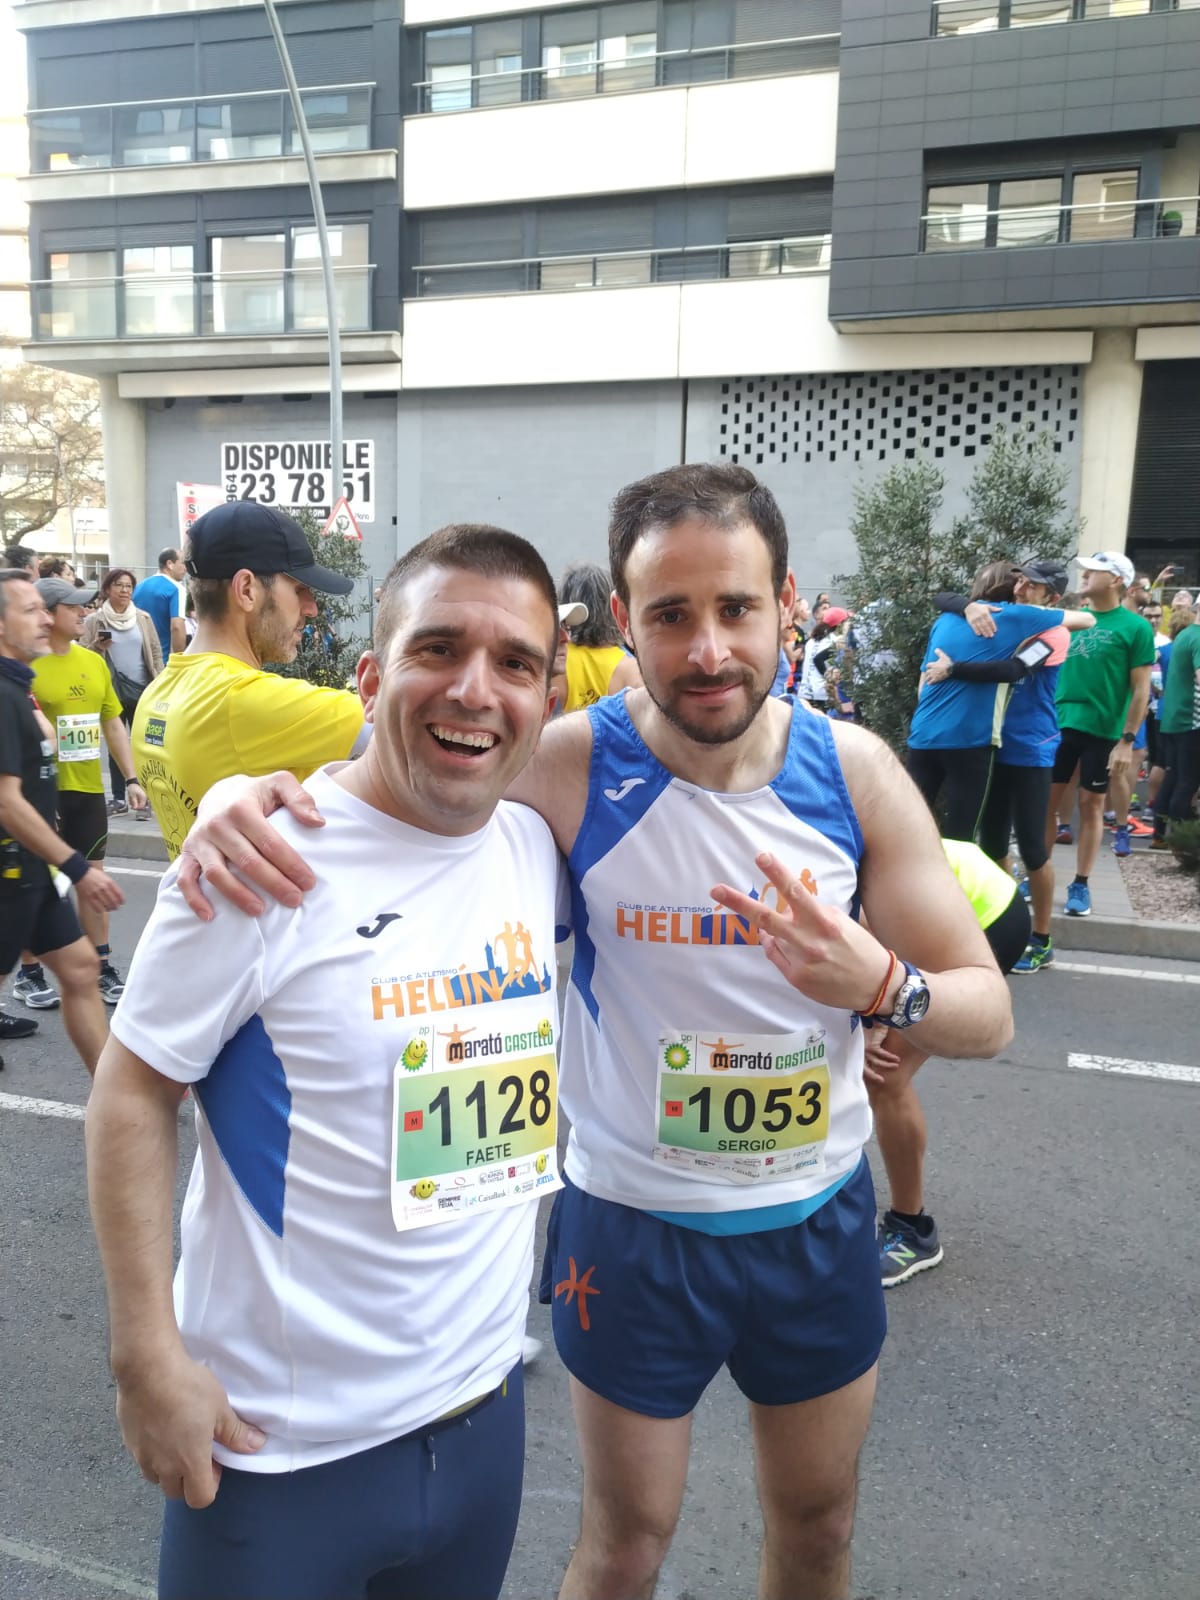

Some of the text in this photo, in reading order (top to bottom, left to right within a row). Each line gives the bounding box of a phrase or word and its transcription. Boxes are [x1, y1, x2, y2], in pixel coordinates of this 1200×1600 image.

[226, 474, 238, 503] 964
[240, 473, 275, 503] 23
[288, 472, 325, 503] 78
[67, 729, 99, 745] 1014
[644, 904, 657, 912] DE
[659, 906, 713, 914] ATLETISMO
[400, 974, 413, 983] DE
[415, 968, 458, 980] ATLETISMO
[448, 1033, 502, 1061] marató
[713, 1044, 825, 1070] marató CASTELLÓ
[410, 1069, 551, 1147] M 1128
[689, 1081, 821, 1134] 1053
[466, 1142, 512, 1166] FAETE
[717, 1138, 777, 1152] SERGIO
